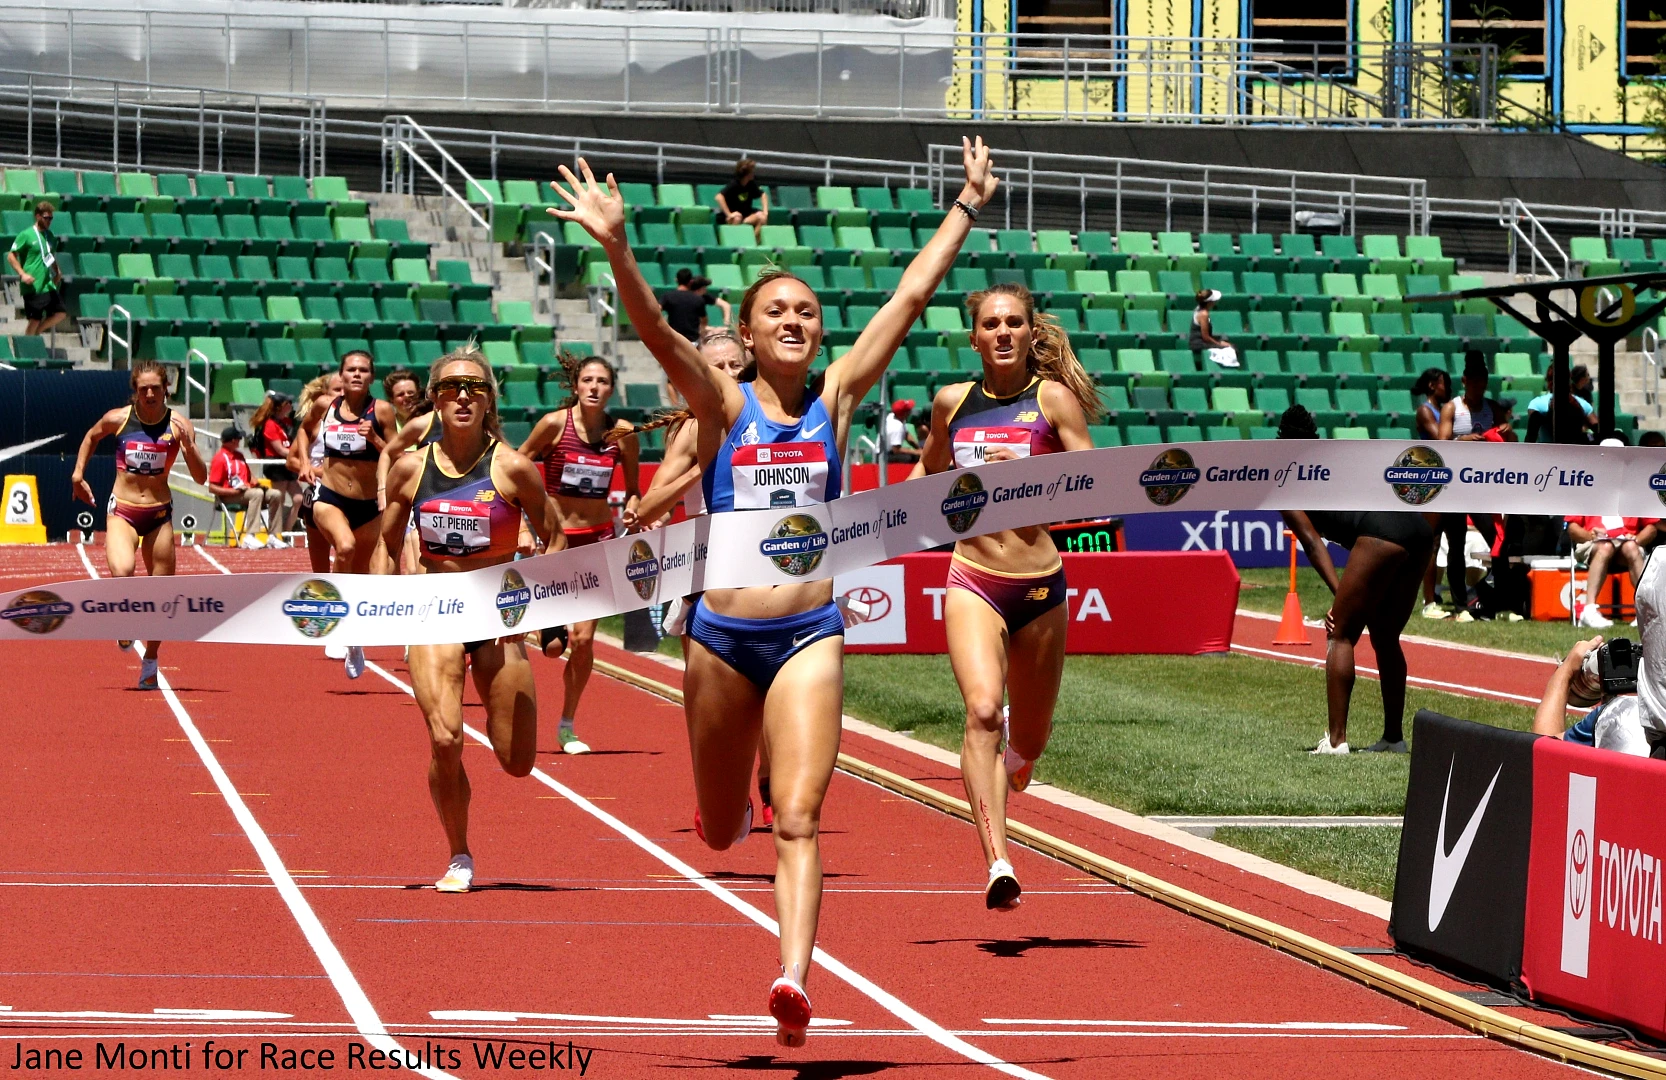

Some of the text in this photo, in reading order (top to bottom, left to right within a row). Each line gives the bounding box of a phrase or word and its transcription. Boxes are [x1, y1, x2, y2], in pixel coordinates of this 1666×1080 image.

[336, 433, 355, 442] NORRIS
[134, 451, 158, 461] MACKAY
[773, 450, 804, 458] TOYOTA
[753, 466, 810, 487] JOHNSON
[1141, 470, 1197, 483] Garden of Life
[1205, 461, 1331, 487] Garden of Life
[1386, 469, 1449, 482] Garden of Life
[1459, 466, 1595, 493] Garden of Life
[992, 473, 1094, 504] Garden of Life
[11, 490, 28, 515] 3
[942, 494, 985, 511] Garden of Life
[432, 515, 479, 531] ST. PIERRE
[831, 508, 908, 545] Garden of Life
[762, 535, 827, 552] Garden of Life
[660, 542, 708, 572] Garden of Life
[533, 570, 600, 600] Garden of Life
[81, 594, 225, 619] Garden of Life
[356, 595, 465, 623] Garden of Life
[1599, 839, 1663, 945] TOYOTA
